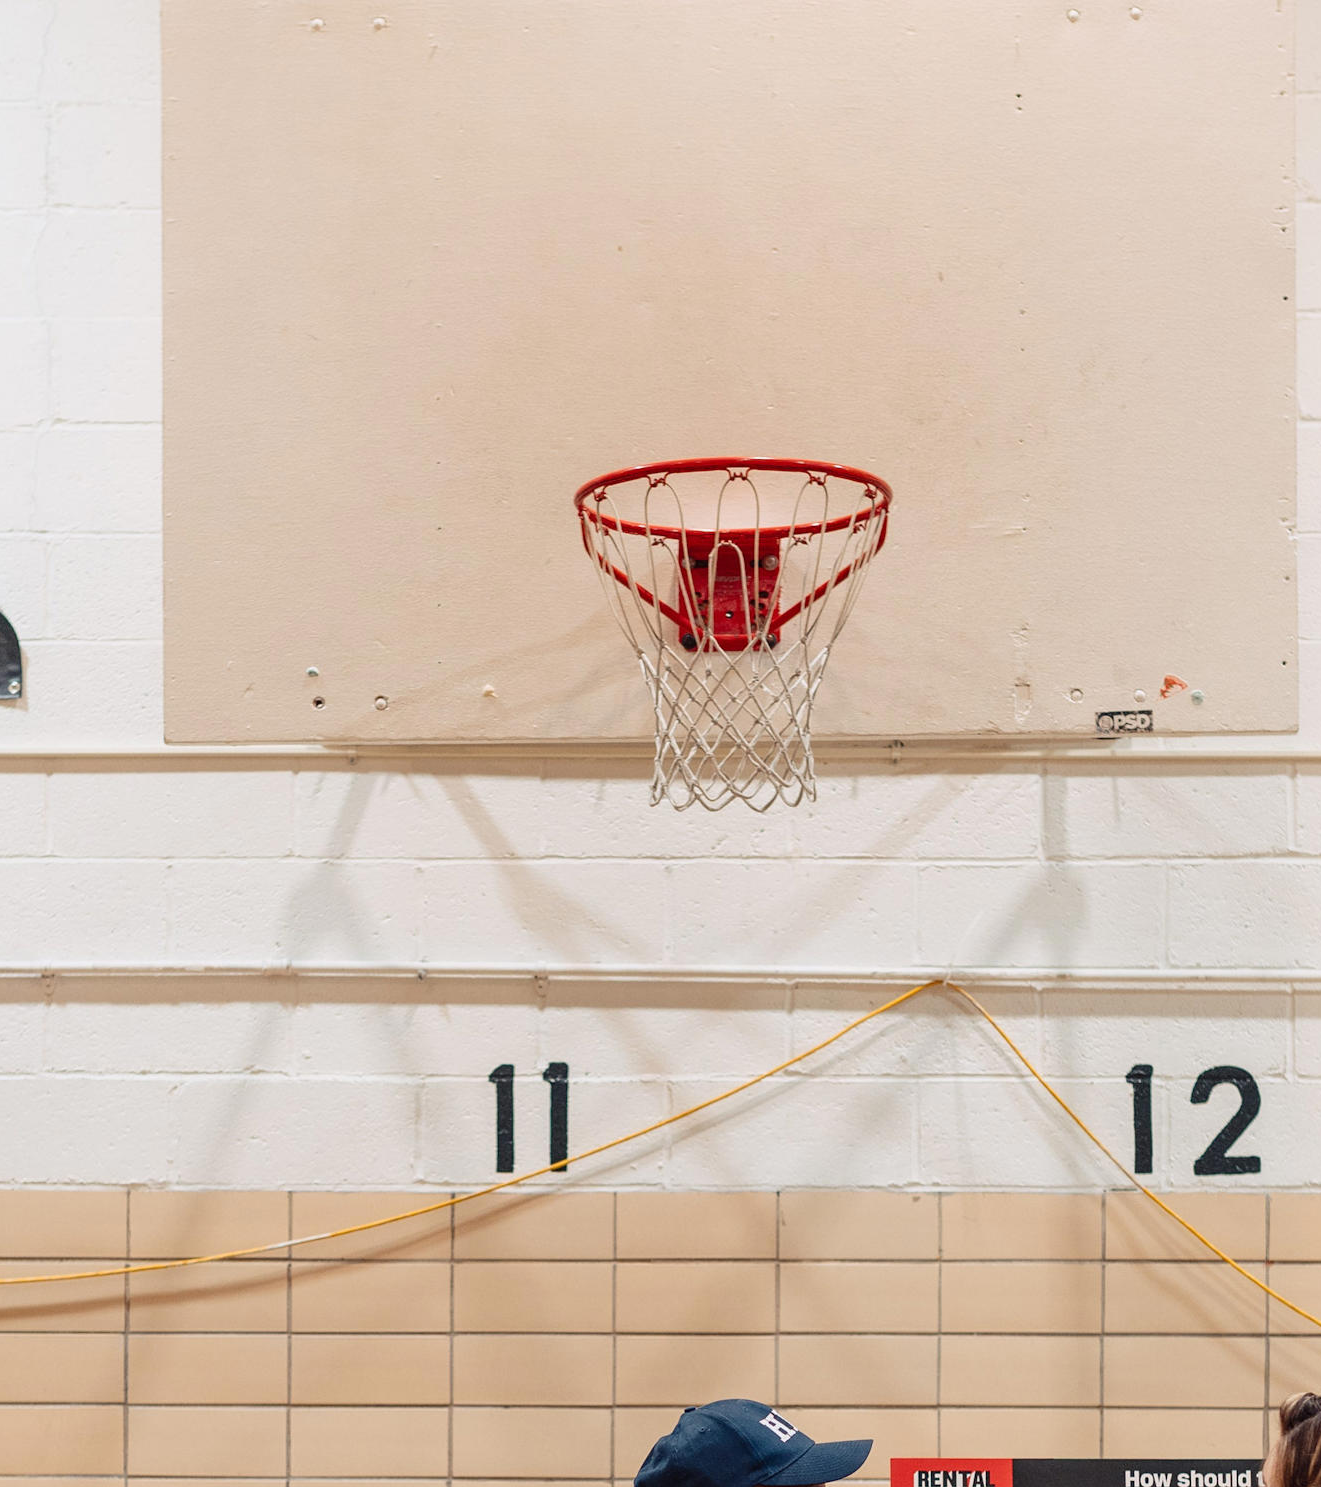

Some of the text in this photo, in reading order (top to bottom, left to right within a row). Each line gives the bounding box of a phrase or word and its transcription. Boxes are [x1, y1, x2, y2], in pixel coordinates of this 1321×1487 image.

[489, 1062, 570, 1173] 11
[1125, 1063, 1262, 1176] 12
[915, 1470, 995, 1487] RENTAL
[1124, 1469, 1251, 1487] How should
